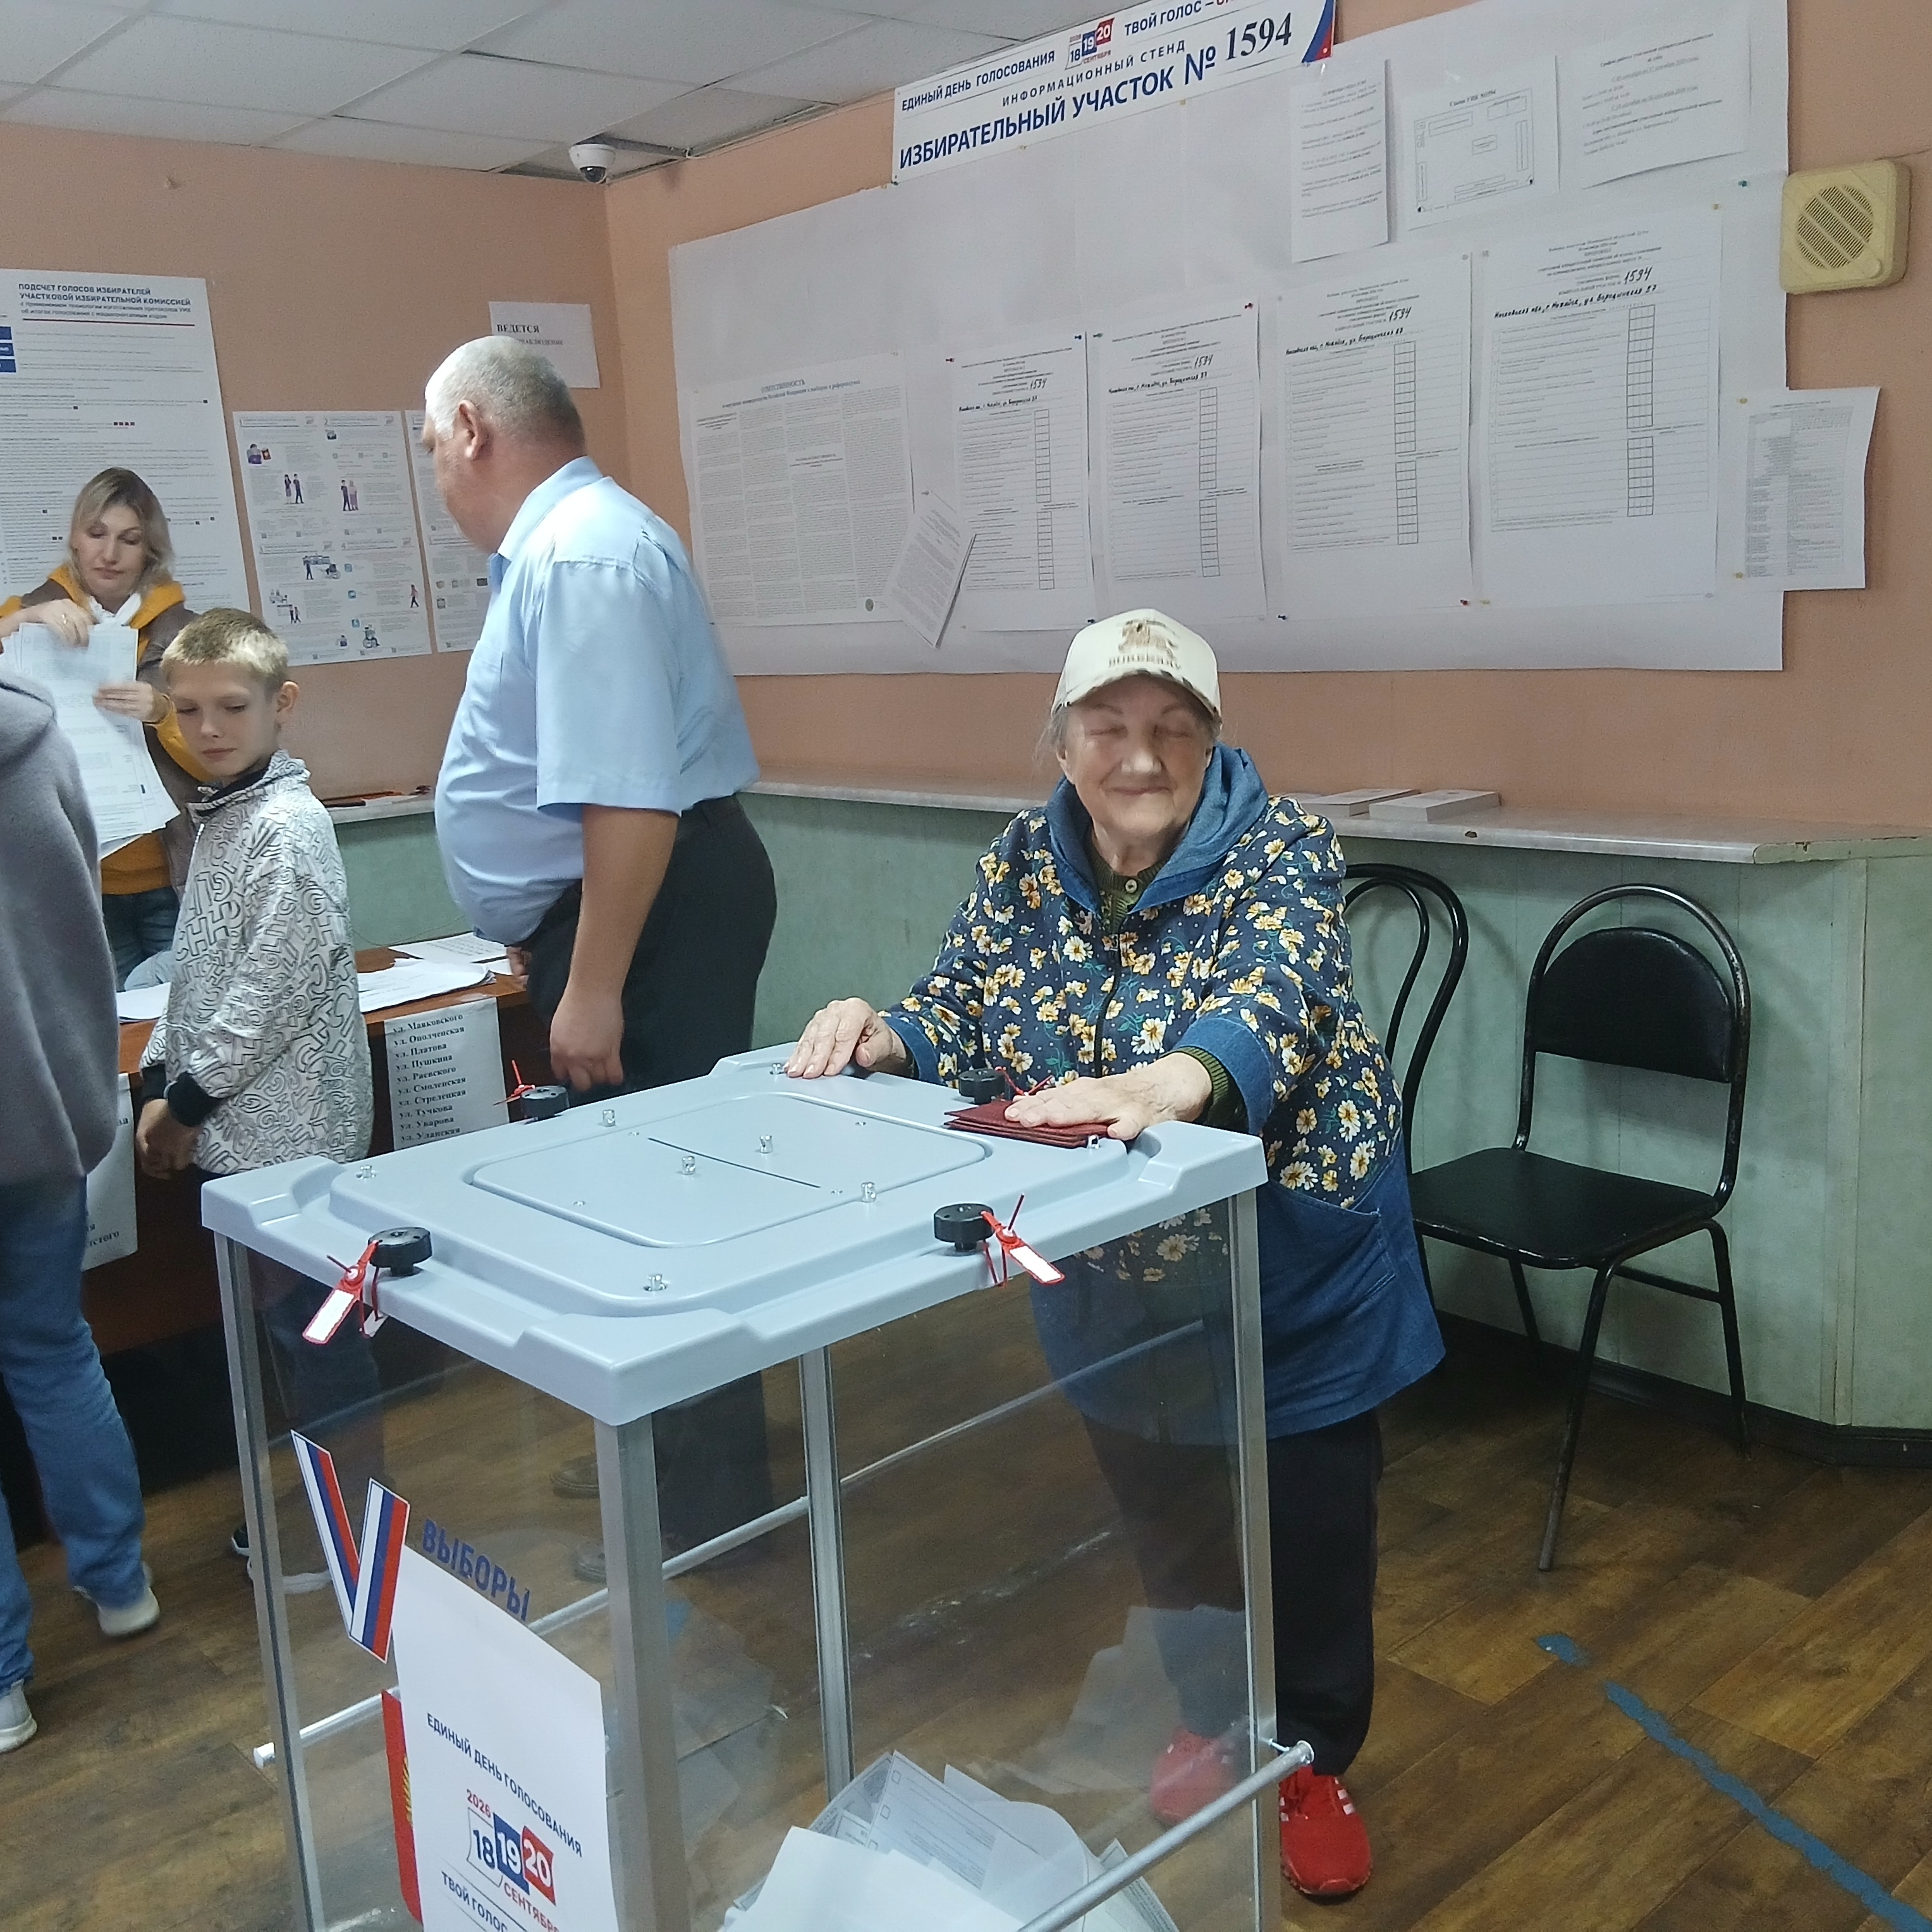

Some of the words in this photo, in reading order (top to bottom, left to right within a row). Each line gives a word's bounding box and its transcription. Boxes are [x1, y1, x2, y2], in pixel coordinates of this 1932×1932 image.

[1125, 13, 1156, 36] ТВОЙ
[1160, 1, 1201, 25] ГОЛОС
[1070, 49, 1080, 63] 18
[1083, 36, 1095, 52] 19
[1096, 24, 1111, 41] 20
[902, 85, 943, 111] ЕДИНЫЙ
[945, 79, 972, 100] ДЕНЬ
[975, 51, 1055, 87] ГОЛОСОВАНИЯ
[1003, 55, 1134, 107] ИНФОРМАЦИОННЫЙ
[1140, 40, 1185, 63] СТЕНД
[900, 96, 1066, 169] ИЗБИРАТЕЛЬНЫЙ
[1073, 66, 1175, 118] УЧАСТОК
[1185, 46, 1216, 85] №
[1225, 12, 1292, 61] 1594
[1623, 266, 1653, 284] 1594
[20, 293, 74, 301] УЧАСТКОВОЙ
[75, 295, 142, 303] ИЗБИРАТЕЛЬНОЙ
[144, 297, 191, 305] КОМИССИЕЙ
[96, 287, 151, 295] ИЗБИРАТЕЛЕЙ
[1388, 307, 1412, 322] 1594
[497, 324, 539, 333] ВЕДЕТСЯ
[1194, 354, 1213, 369] 1594
[408, 1014, 463, 1030] Маяковского
[409, 1027, 465, 1043] Ополченская
[411, 1043, 447, 1056] Платова
[412, 1055, 453, 1068] Пушкина
[412, 1067, 456, 1080] Раевского
[413, 1077, 466, 1092] Смоленская
[415, 1090, 466, 1104] Стрелецкая
[415, 1105, 453, 1117] Тучкова
[416, 1117, 455, 1128] Уварова
[422, 1519, 530, 1622] ВЫБОРЫ
[427, 1713, 472, 1758] ЕДИНЫЙ
[474, 1749, 502, 1782] ДЕНЬ
[504, 1773, 582, 1857] ГОЛОСОВАНИЯ
[467, 1788, 491, 1818] 2026
[474, 1830, 495, 1869] 18
[497, 1832, 521, 1874] 19
[523, 1839, 551, 1887] 20
[442, 1871, 470, 1905] ТВОЙ
